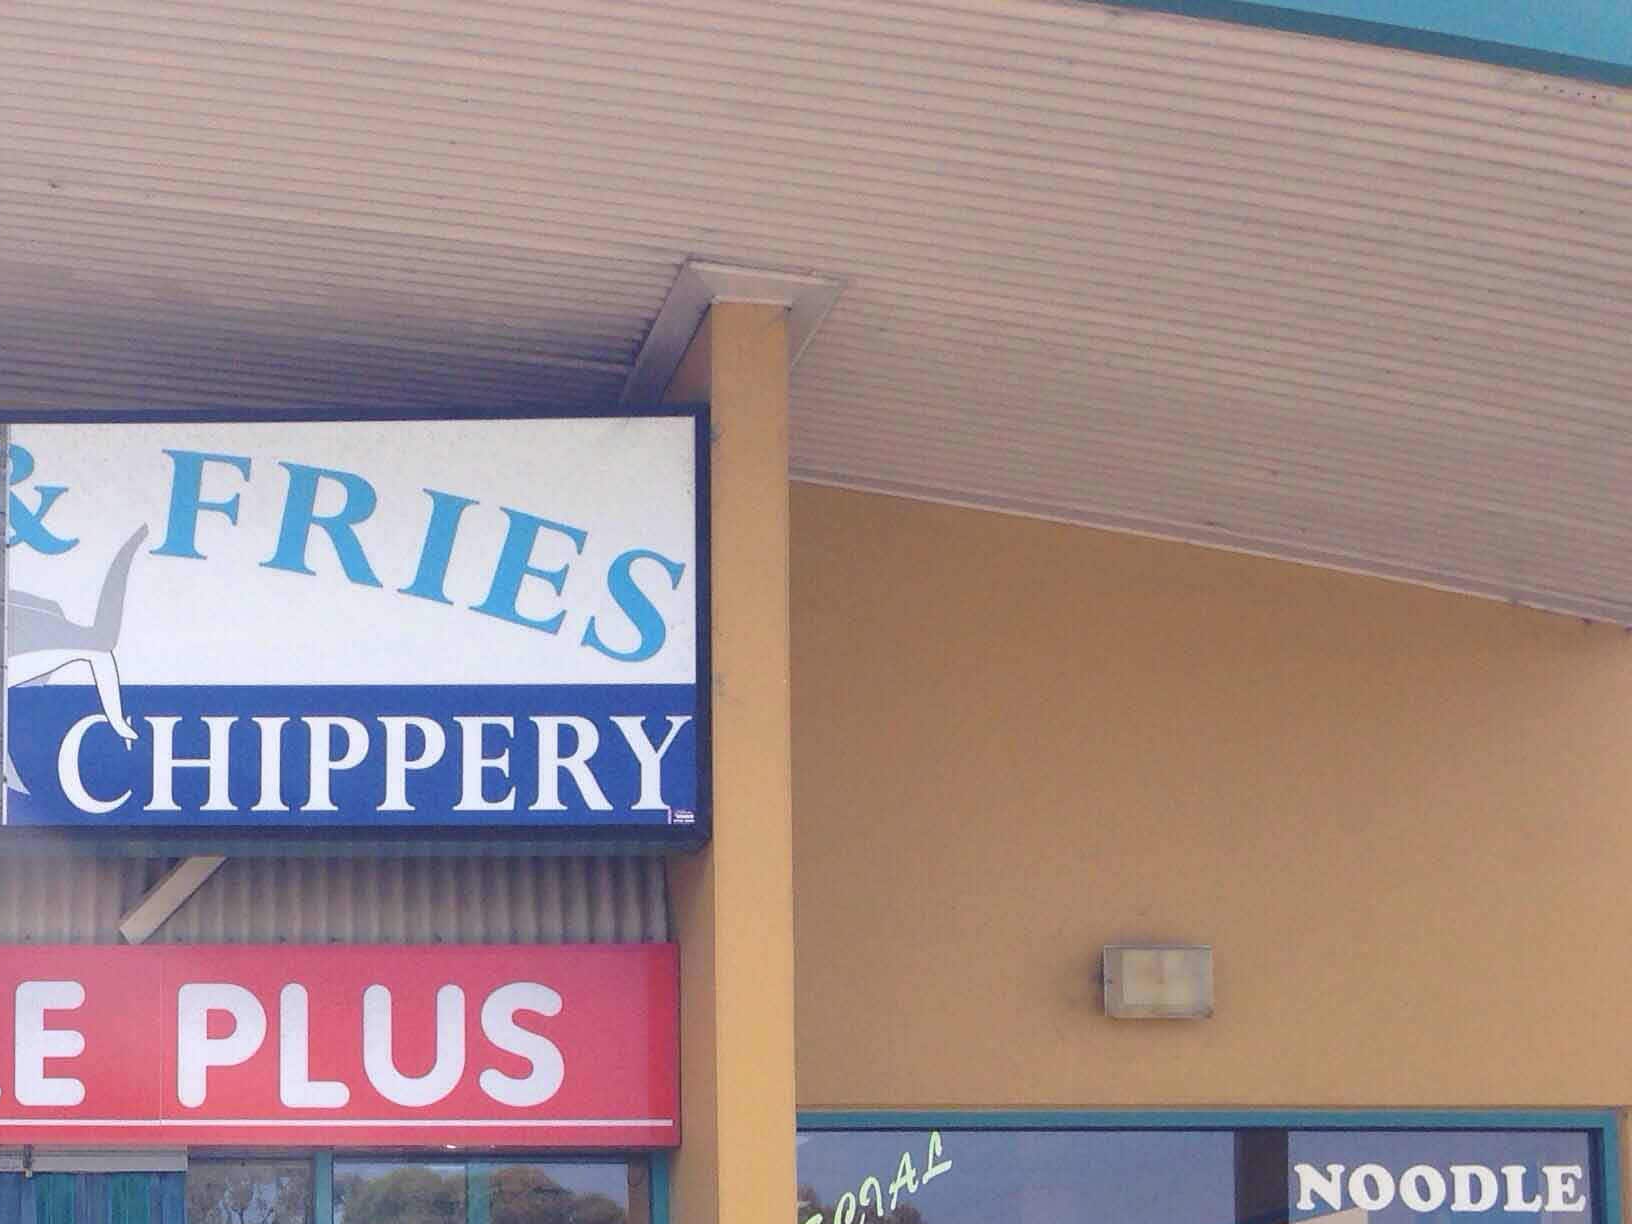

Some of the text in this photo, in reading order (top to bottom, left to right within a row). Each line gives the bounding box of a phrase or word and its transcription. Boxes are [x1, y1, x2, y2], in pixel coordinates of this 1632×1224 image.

[149, 448, 686, 663] FRIES
[57, 714, 692, 813] CHIPPERY
[177, 982, 565, 1108] PLUS
[1294, 1164, 1586, 1212] NOODLE
